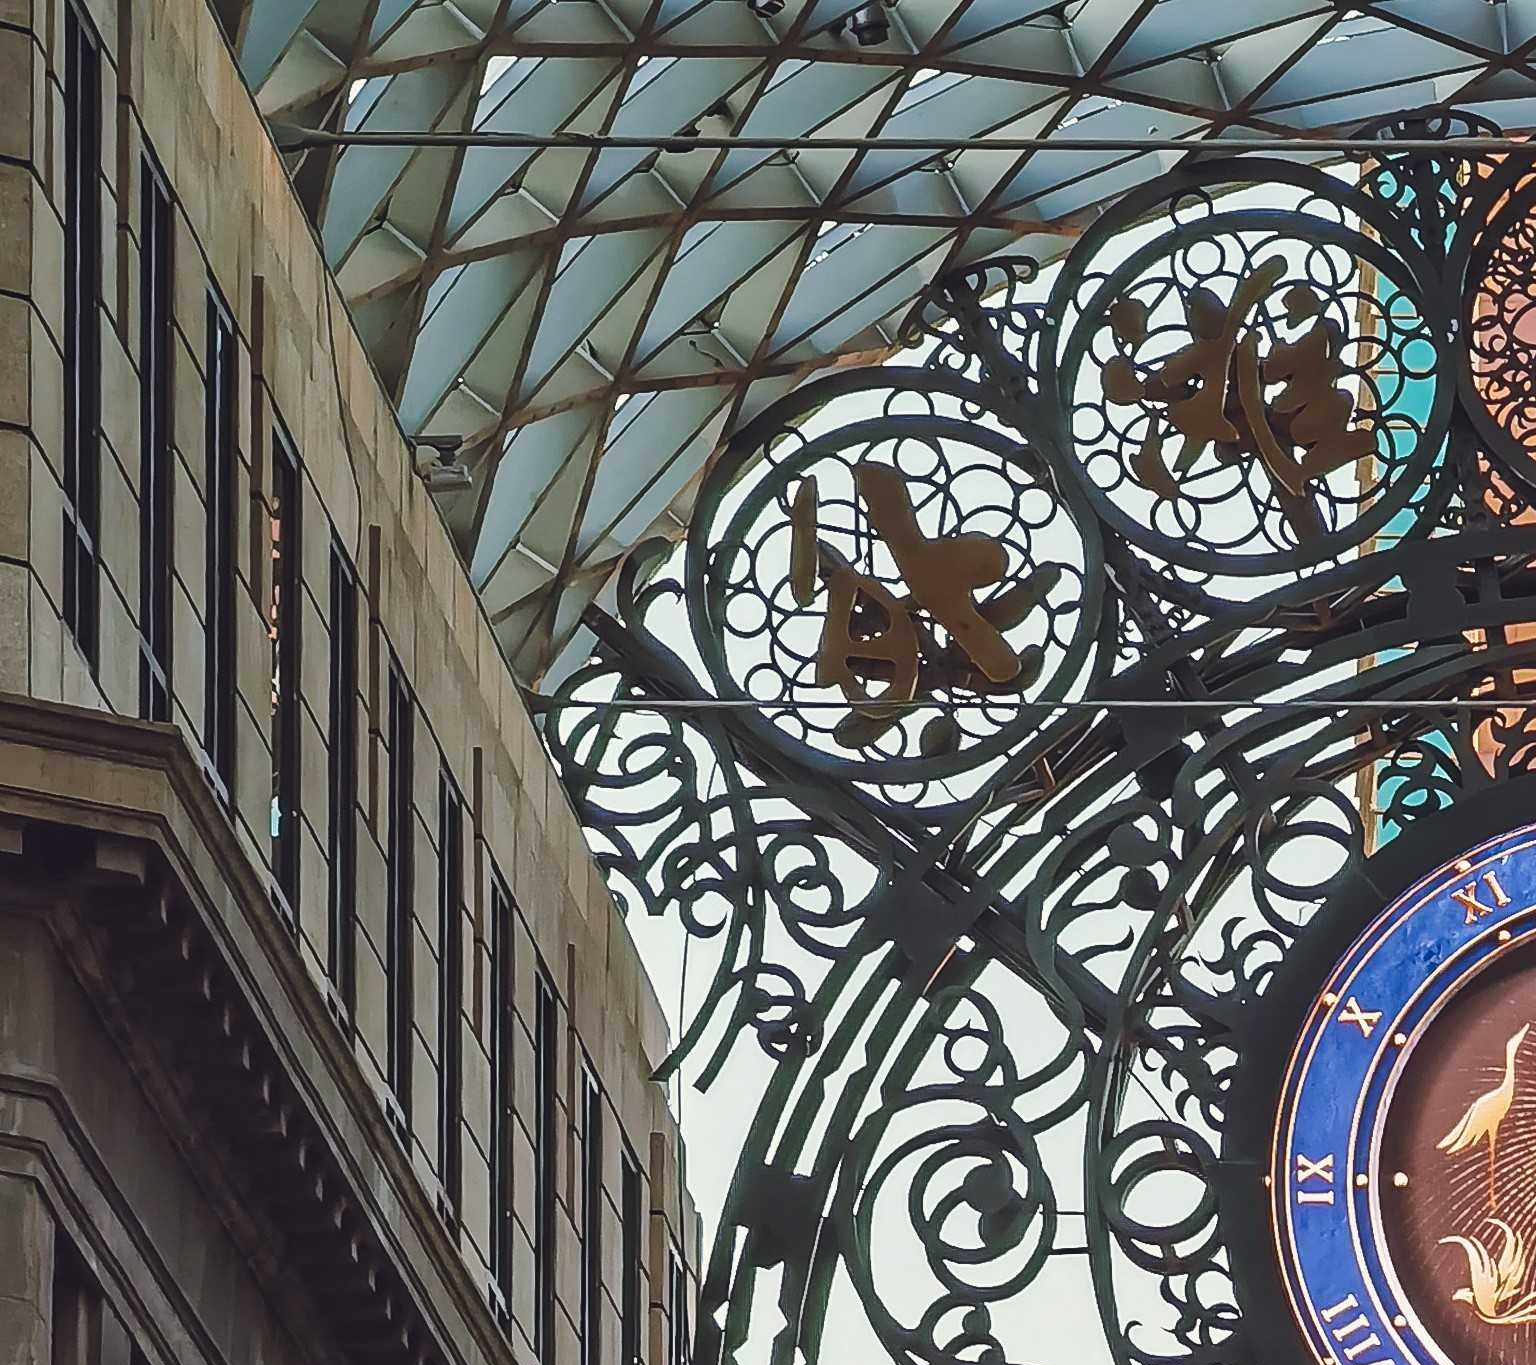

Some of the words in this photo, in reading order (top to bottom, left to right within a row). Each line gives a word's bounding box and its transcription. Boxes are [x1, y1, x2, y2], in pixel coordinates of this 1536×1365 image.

[1450, 873, 1514, 923] XI
[1337, 996, 1382, 1038] X
[1296, 1153, 1335, 1204] IX
